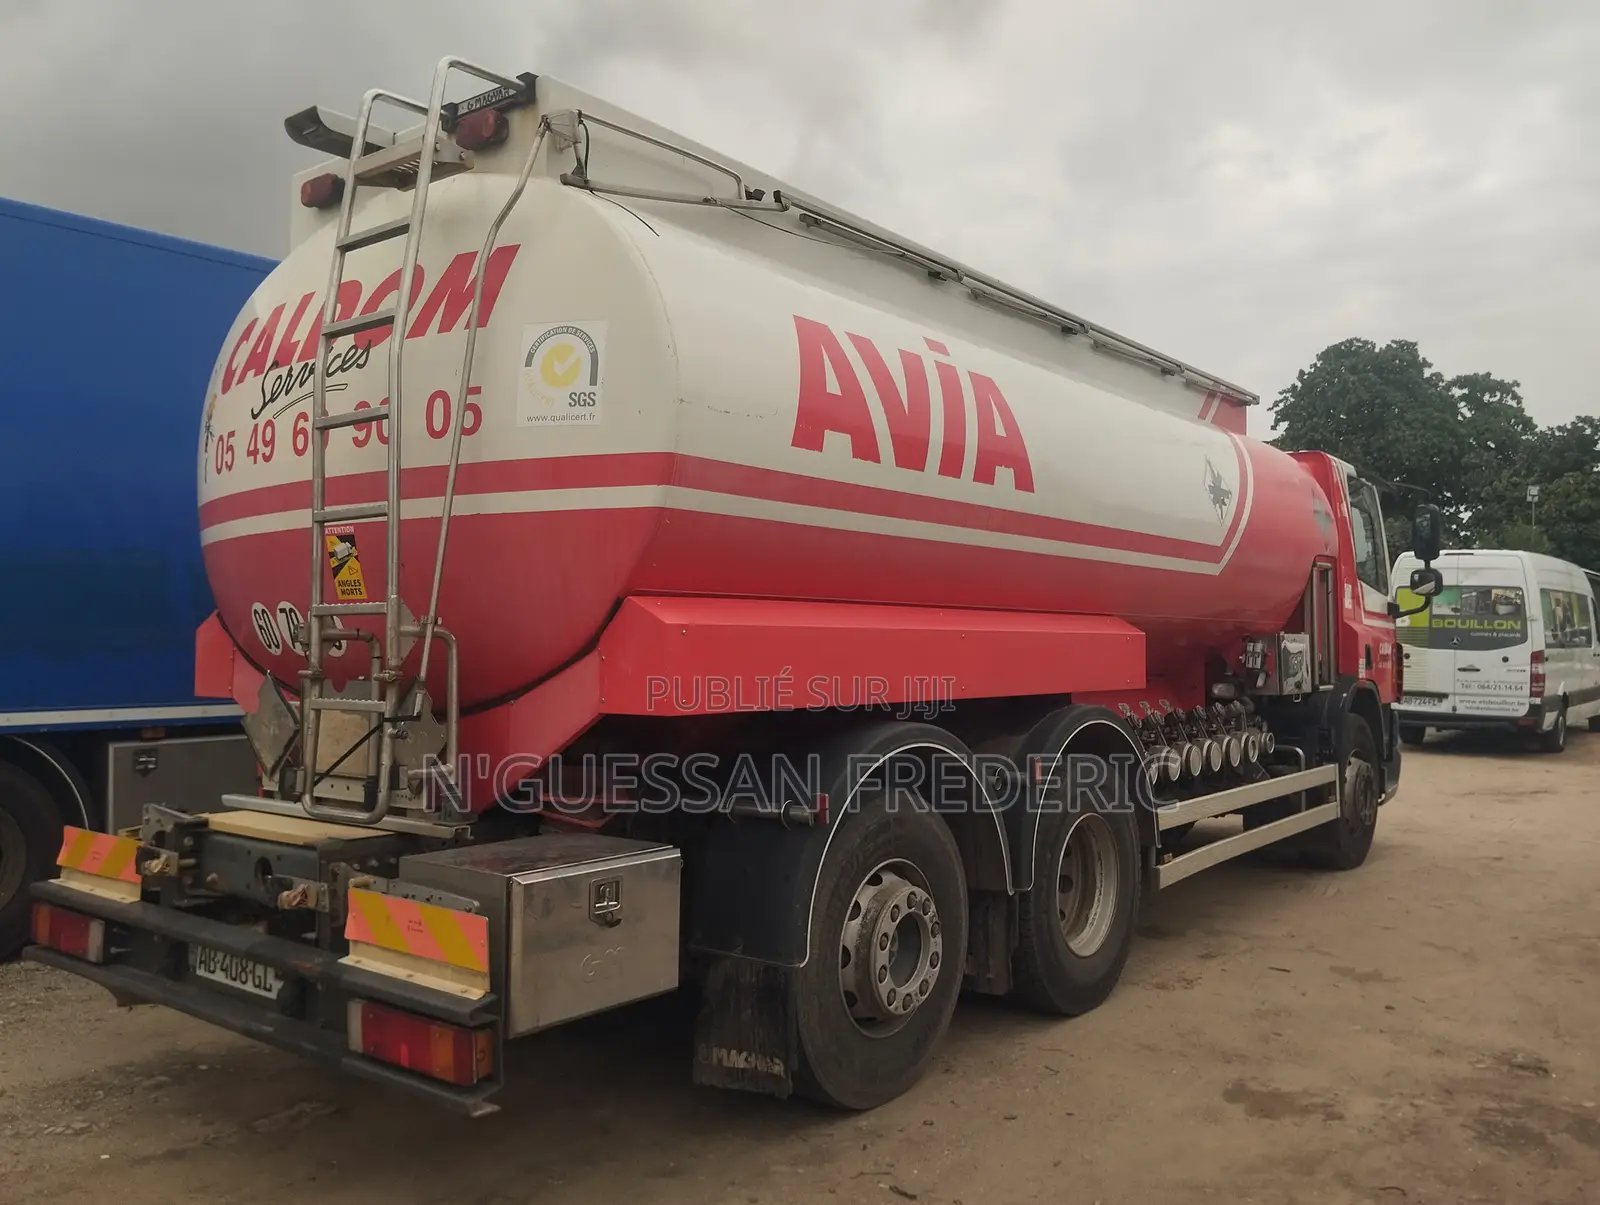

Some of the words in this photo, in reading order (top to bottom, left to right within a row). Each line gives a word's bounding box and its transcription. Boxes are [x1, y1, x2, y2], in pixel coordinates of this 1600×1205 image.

[221, 243, 521, 396] CALDOM
[530, 326, 568, 354] CERTIFICATION
[568, 327, 577, 335] DE
[576, 330, 596, 354] SERVICES
[251, 339, 372, 420] Servces
[568, 391, 597, 407] SGS
[526, 412, 596, 423] www.qualicert.fr
[215, 430, 236, 475] 05
[246, 419, 276, 465] 49
[425, 385, 483, 440] 05
[324, 525, 355, 535] ATTENTION
[337, 579, 362, 588] ANGLES
[340, 587, 363, 597] MORTS
[253, 607, 280, 650] 60
[1431, 618, 1521, 630] BOUILLON
